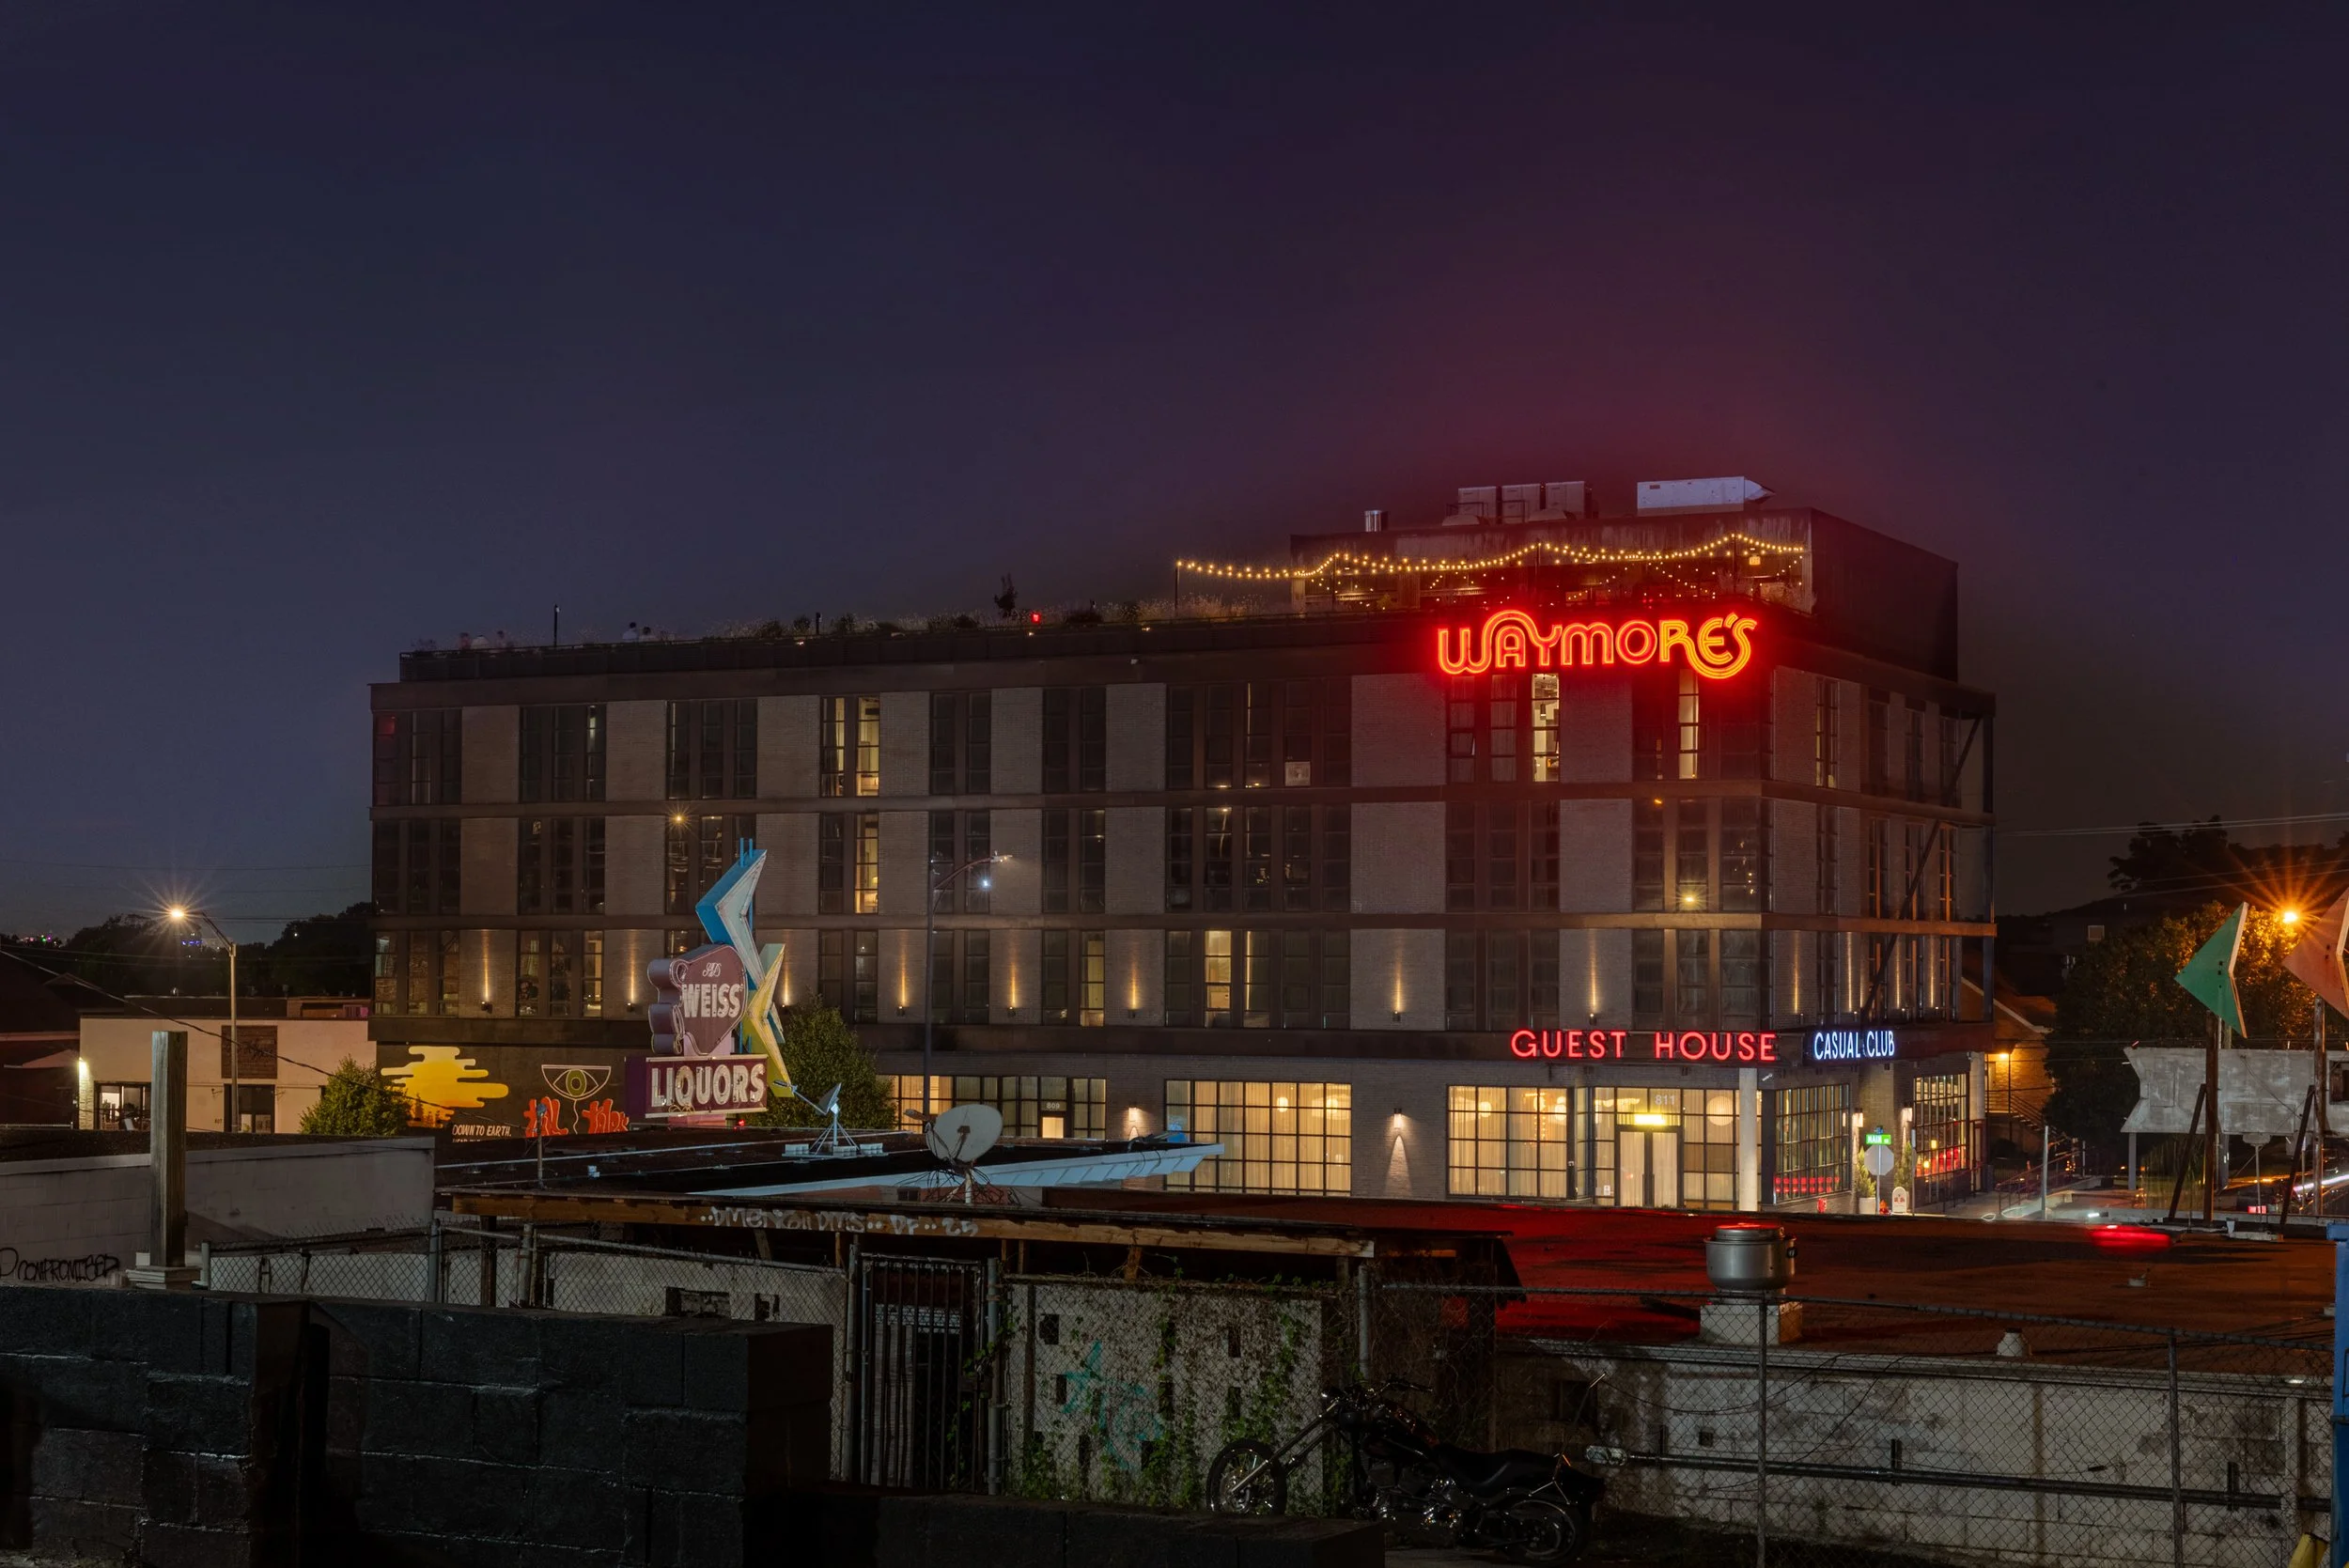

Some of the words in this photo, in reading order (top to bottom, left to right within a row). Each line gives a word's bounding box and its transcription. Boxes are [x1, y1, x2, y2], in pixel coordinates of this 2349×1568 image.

[1438, 609, 1758, 679] WAYMORE'S
[682, 984, 742, 1017] WEISS
[1511, 1030, 1628, 1059] GUEST
[1655, 1031, 1778, 1062] HOUSE
[1813, 1032, 1860, 1061] CASUAL
[1867, 1030, 1896, 1057] CLUB
[651, 1063, 767, 1108] LIQUORS
[1655, 1094, 1676, 1106] 811
[452, 1124, 475, 1136] DOWN
[475, 1125, 486, 1136] TO
[486, 1126, 512, 1137] EARTH.
[1867, 1134, 1882, 1143] MAIN
